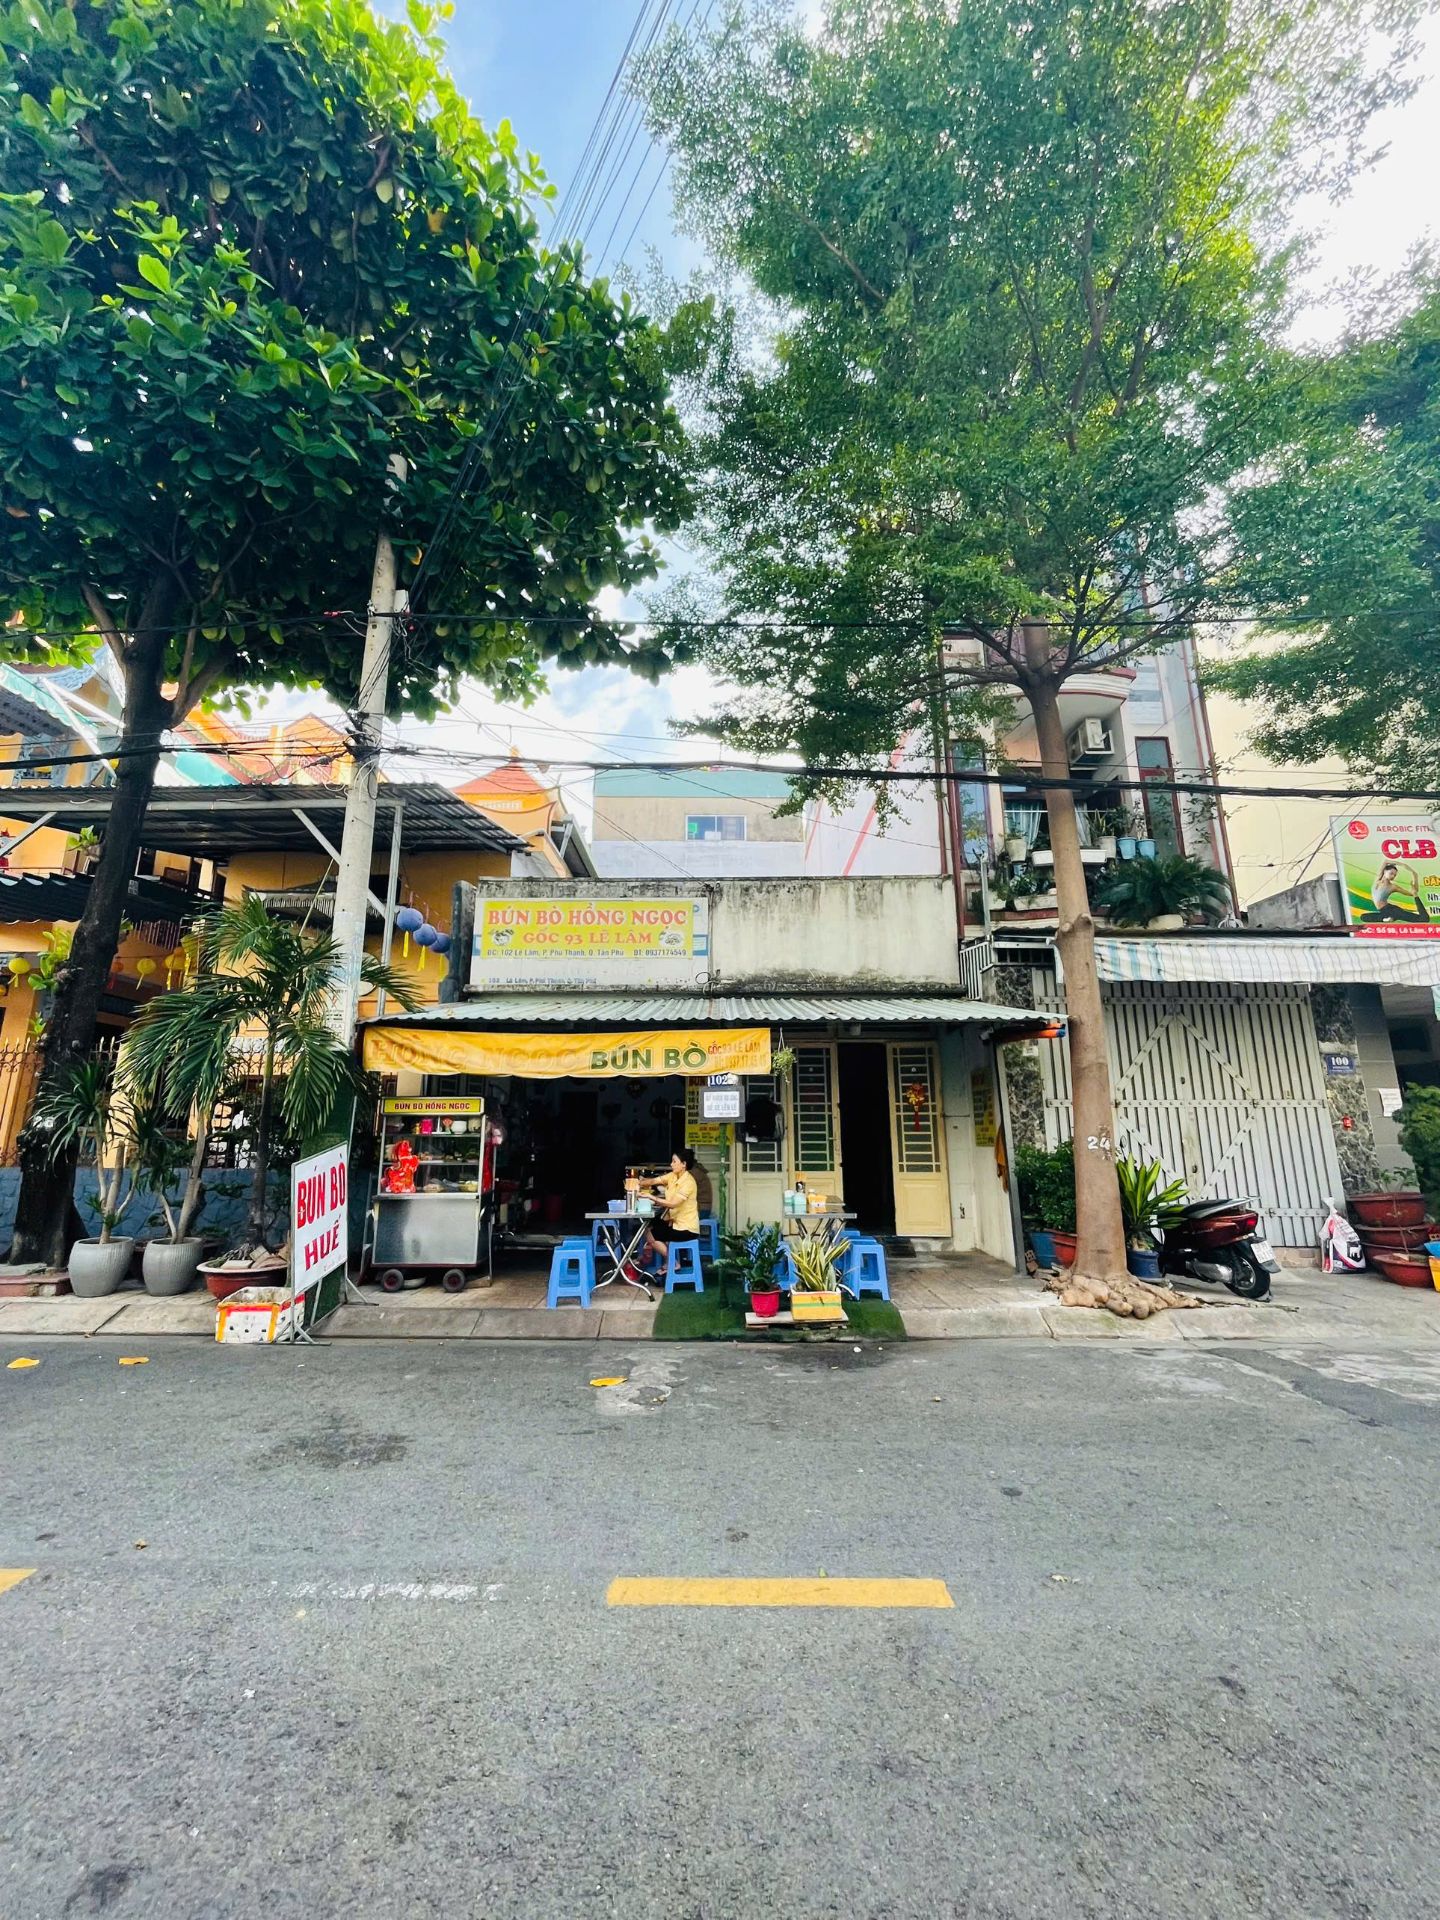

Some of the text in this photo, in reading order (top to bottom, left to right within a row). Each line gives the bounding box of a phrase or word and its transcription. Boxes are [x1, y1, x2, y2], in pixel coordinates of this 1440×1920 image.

[1381, 839, 1438, 860] CLB
[488, 904, 529, 925] BÚN
[536, 904, 562, 925] BÒ
[632, 910, 687, 929] NGỌC
[523, 927, 559, 943] GỐC
[565, 934, 583, 945] 93
[615, 930, 652, 944] LÂM
[590, 1044, 652, 1070] BÚN
[663, 1042, 707, 1069] BÒ
[1331, 1056, 1349, 1066] 100
[710, 1075, 727, 1086] 102
[1087, 1135, 1110, 1150] 24
[297, 1152, 346, 1230] BÚN BÒ
[304, 1213, 340, 1271] HUẾ
